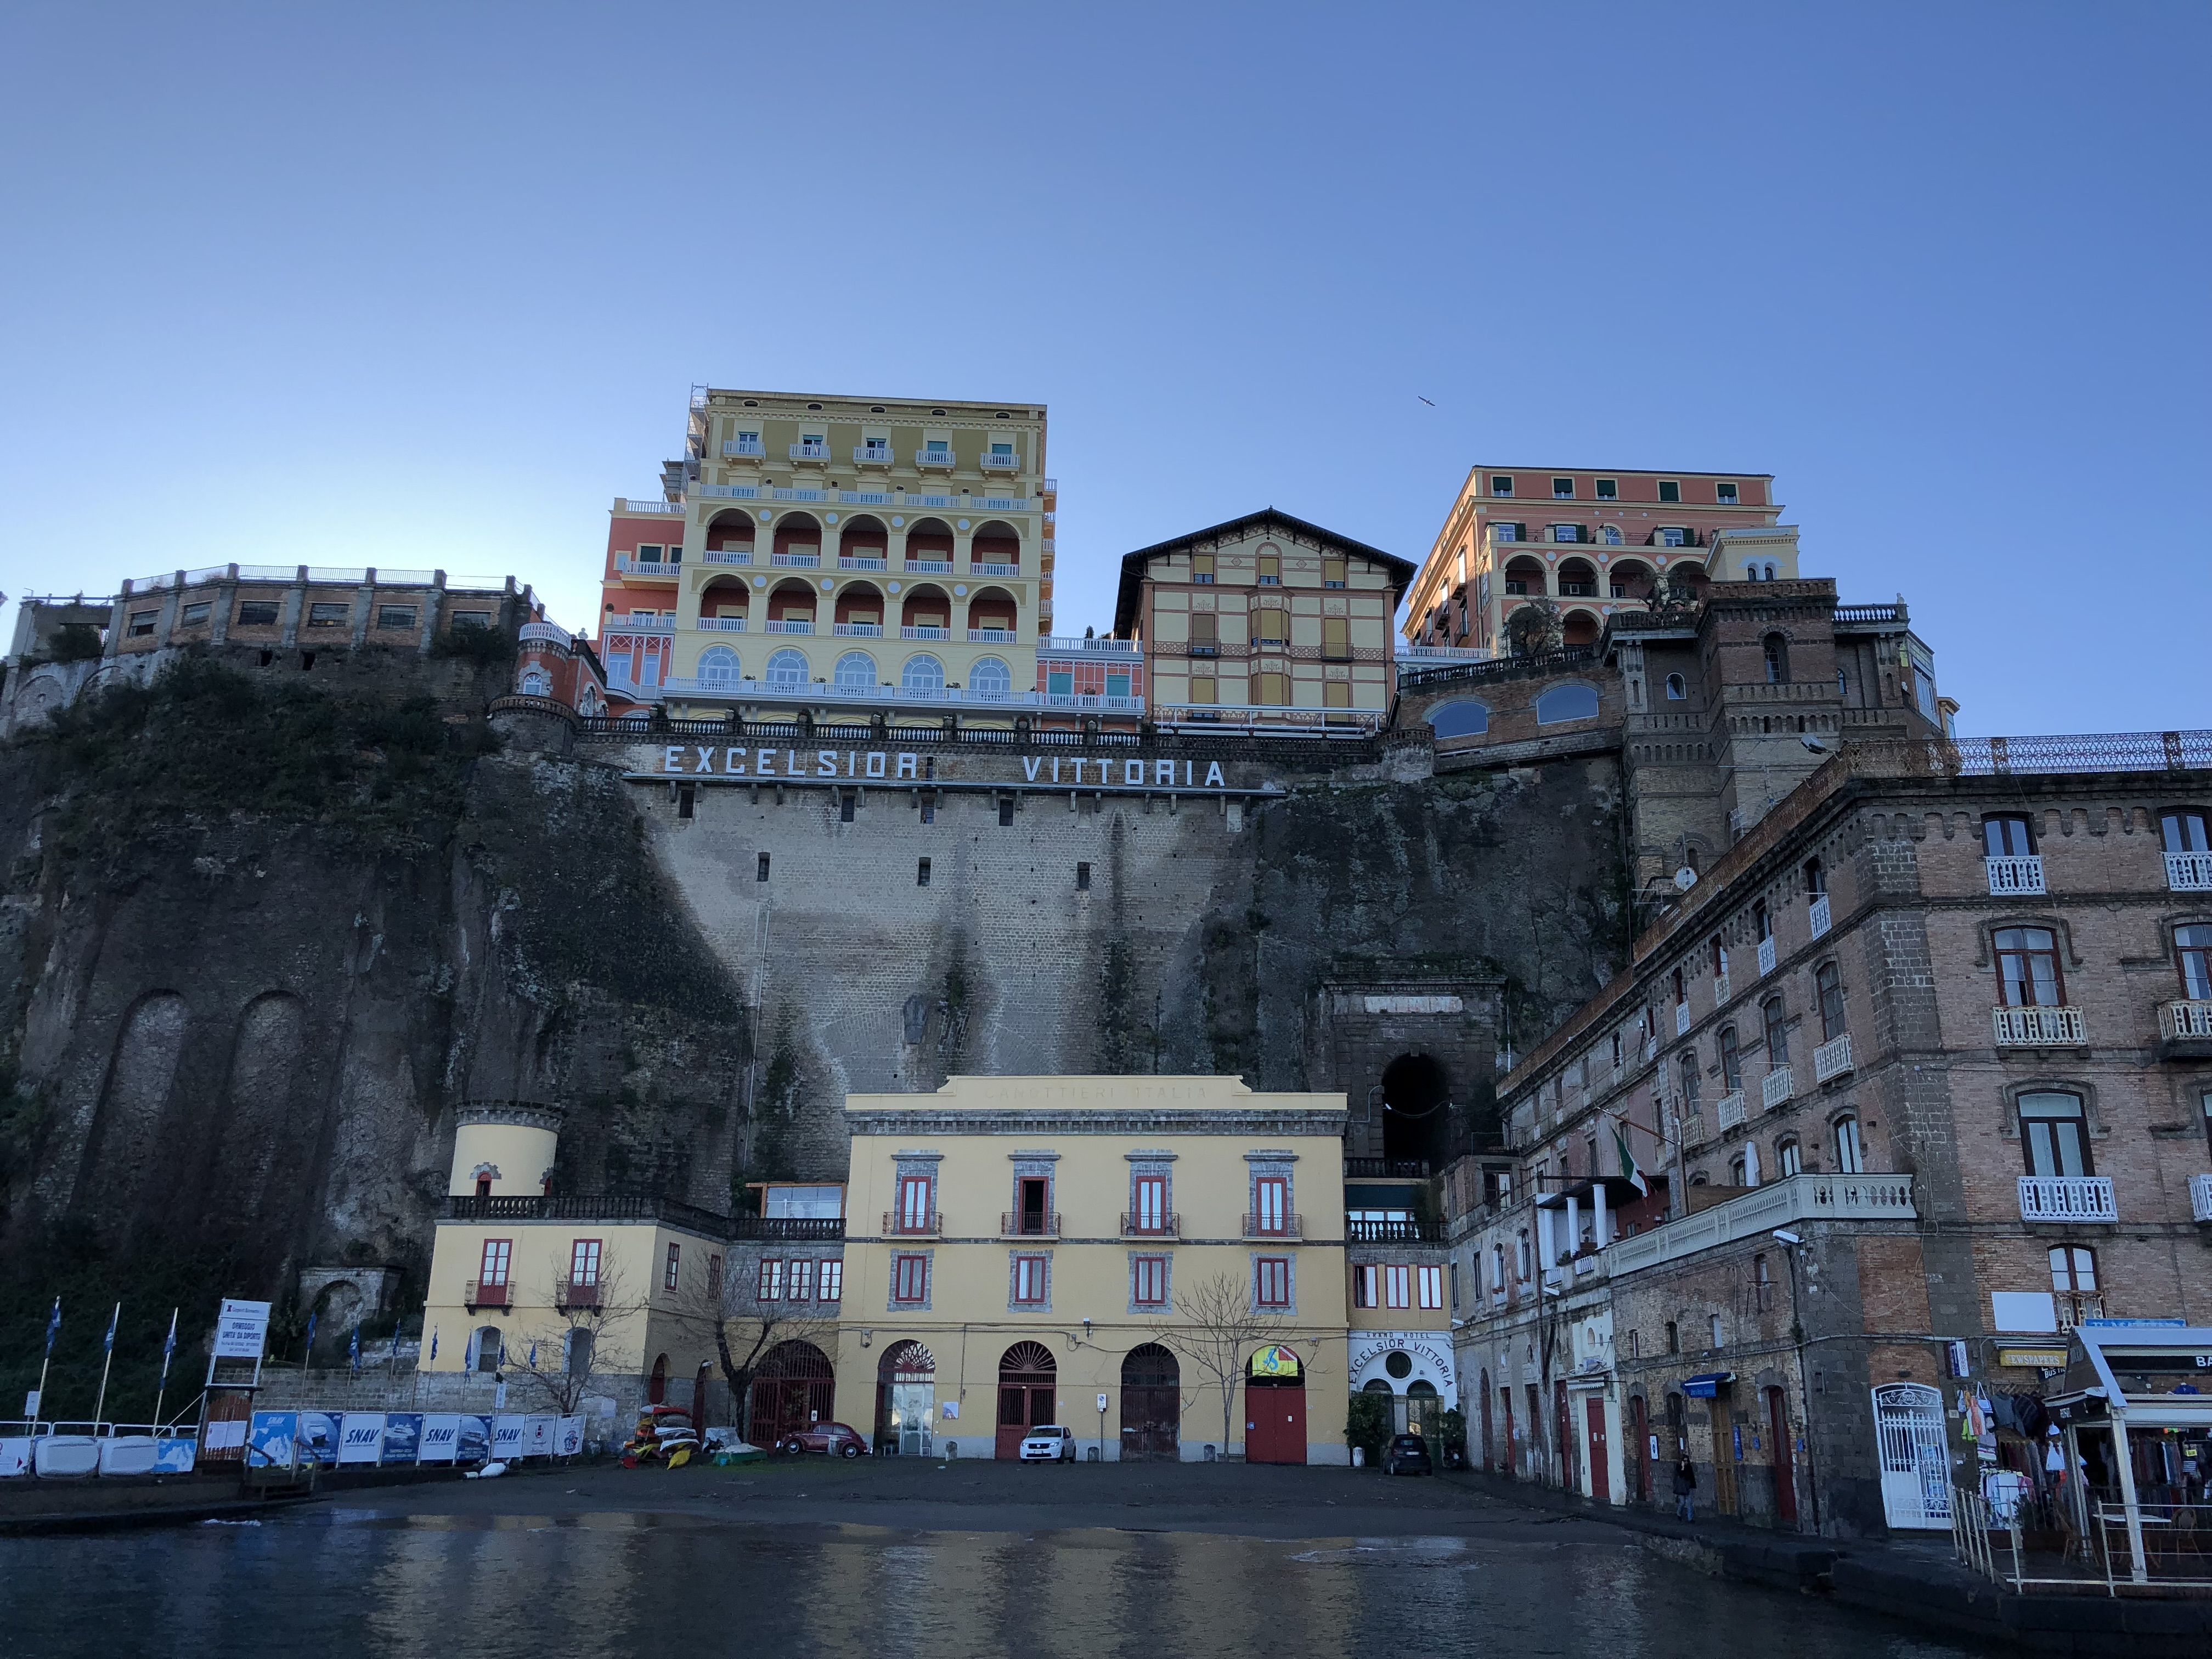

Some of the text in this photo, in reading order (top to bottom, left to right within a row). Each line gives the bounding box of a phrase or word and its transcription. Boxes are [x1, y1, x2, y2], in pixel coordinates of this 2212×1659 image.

[664, 746, 1225, 786] EXCELSIOR VITTORIA
[985, 1087, 1206, 1099] CANOTTIERI ITALIA
[1349, 1339, 1453, 1387] EXCELSIOR VITTORIA
[2045, 1369, 2057, 1379] BUS
[345, 1429, 380, 1443] SNAV
[426, 1429, 455, 1442] SNAV
[495, 1429, 521, 1441] SNAV
